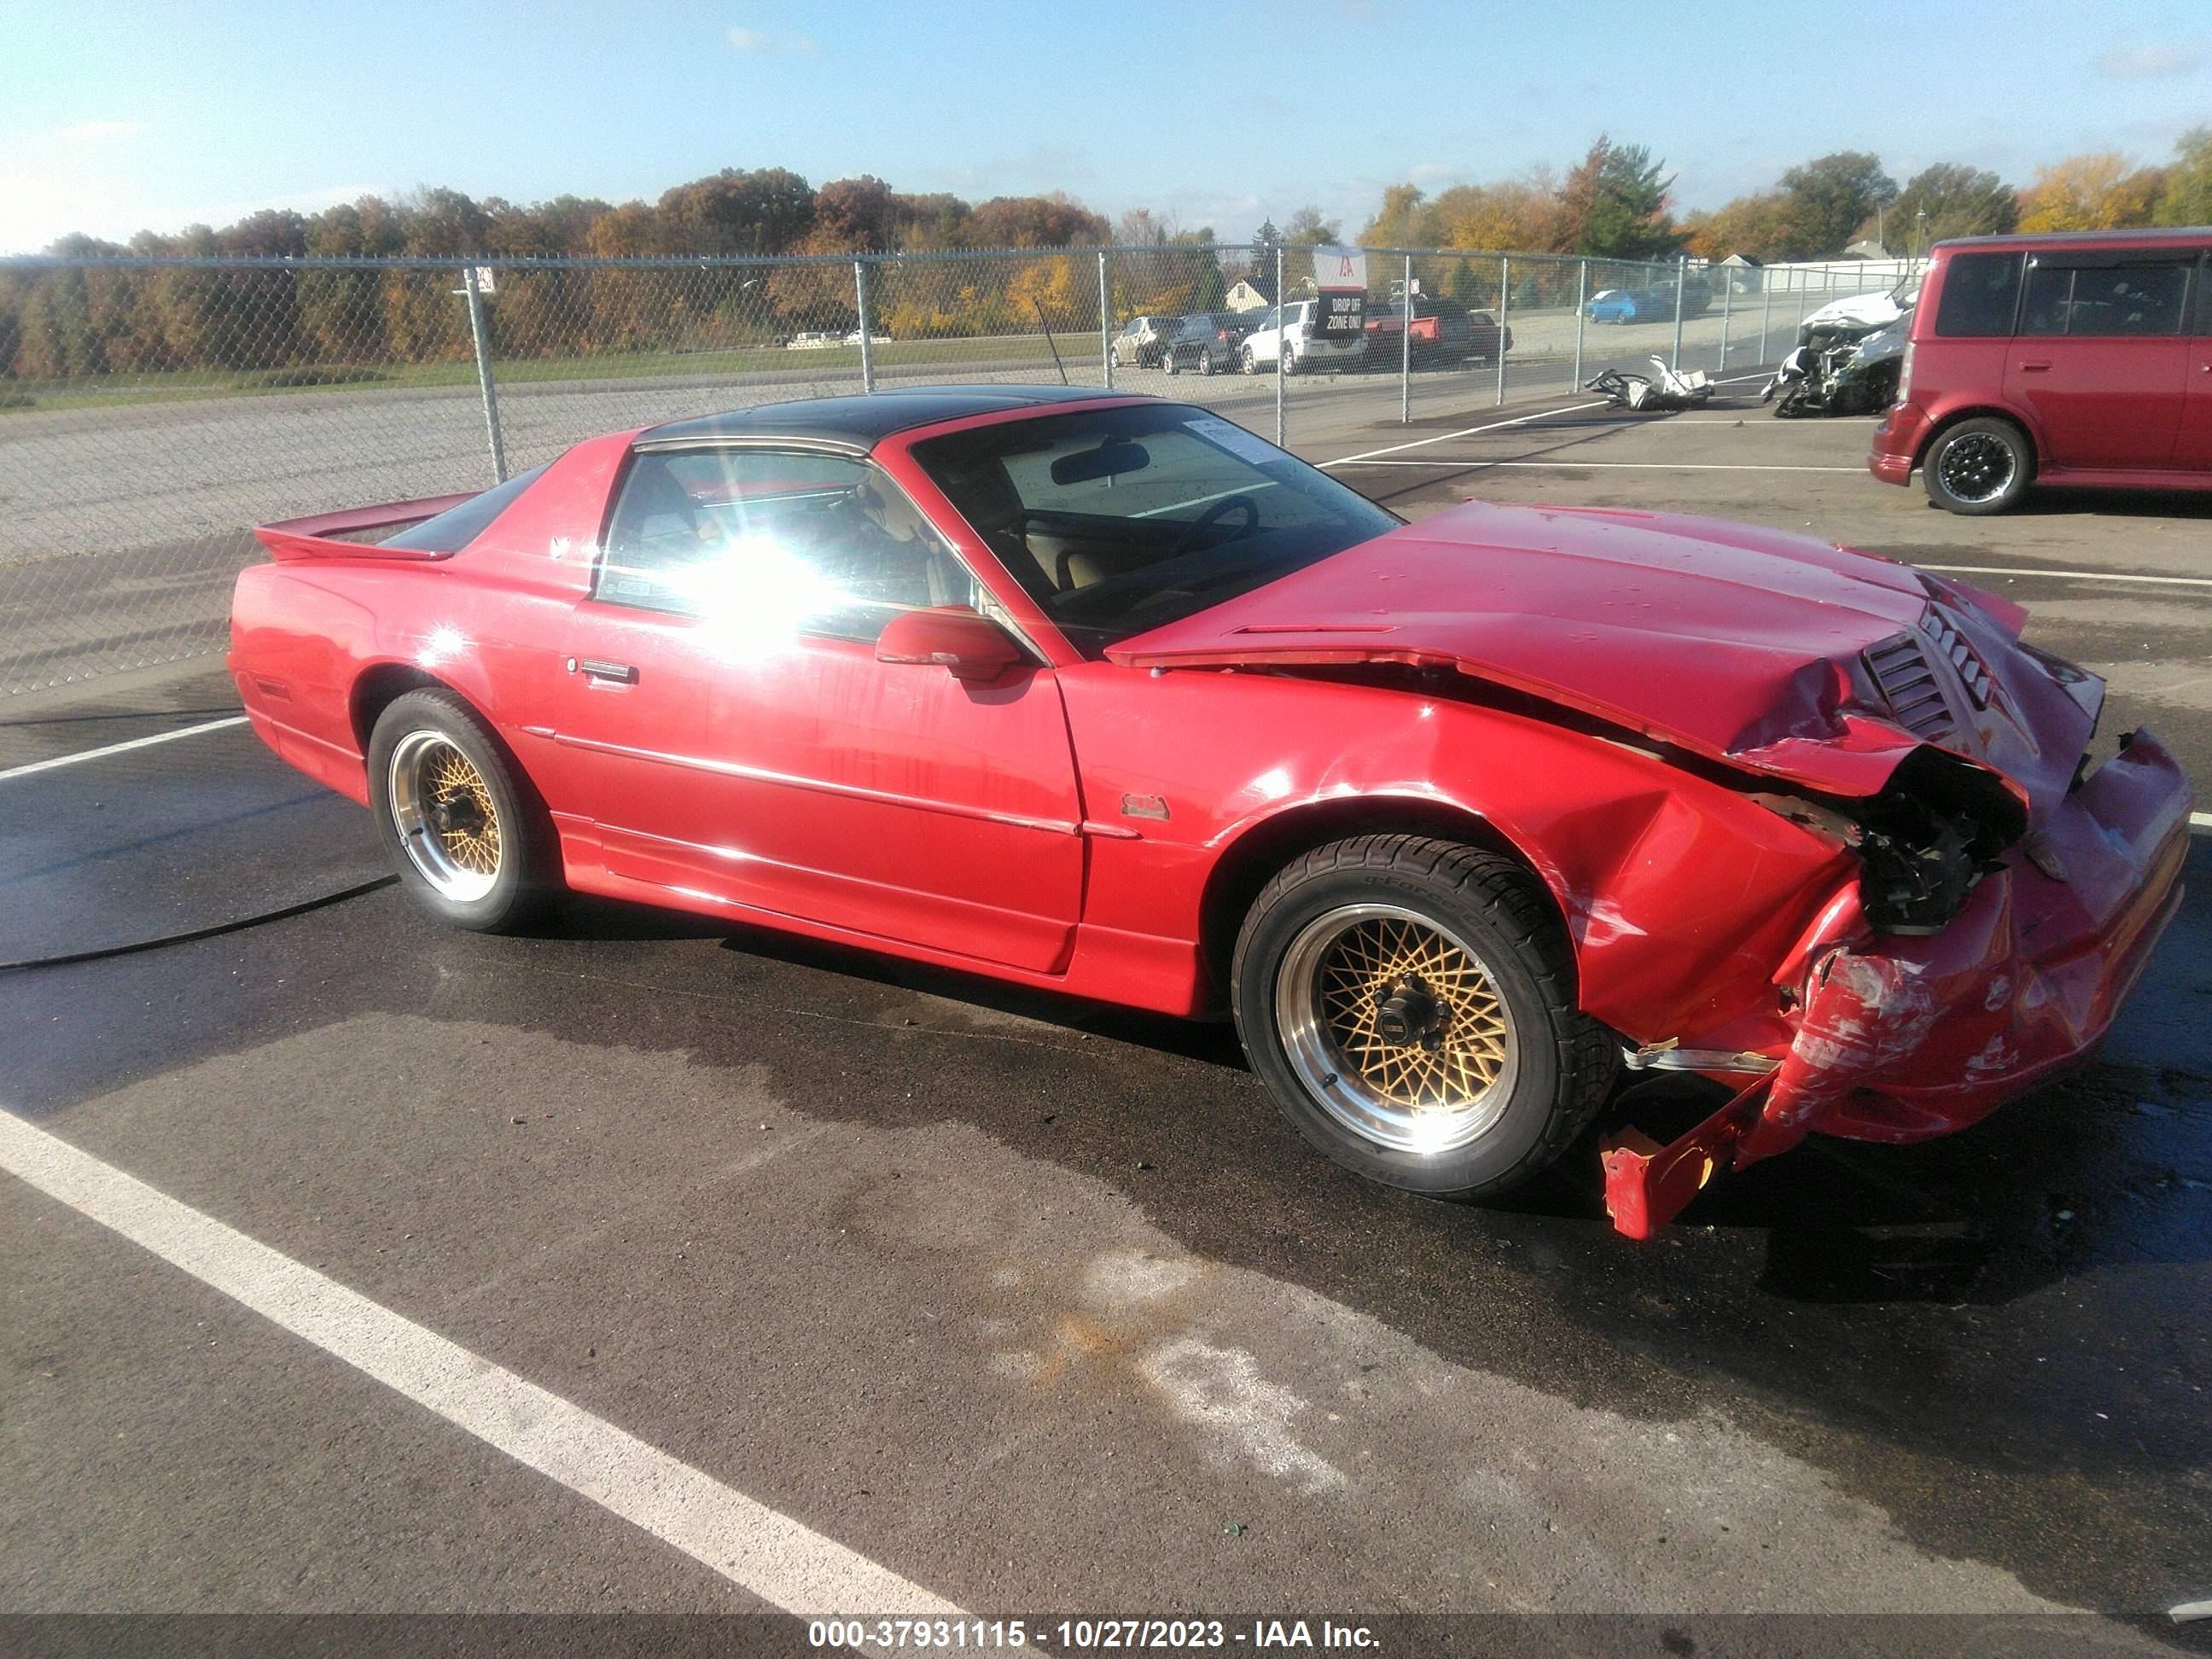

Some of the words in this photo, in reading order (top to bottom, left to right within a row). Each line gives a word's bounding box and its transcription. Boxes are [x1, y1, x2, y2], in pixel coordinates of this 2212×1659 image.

[1332, 299, 1351, 312] DROP
[1351, 299, 1360, 311] OFF
[1327, 316, 1348, 329] ZONE
